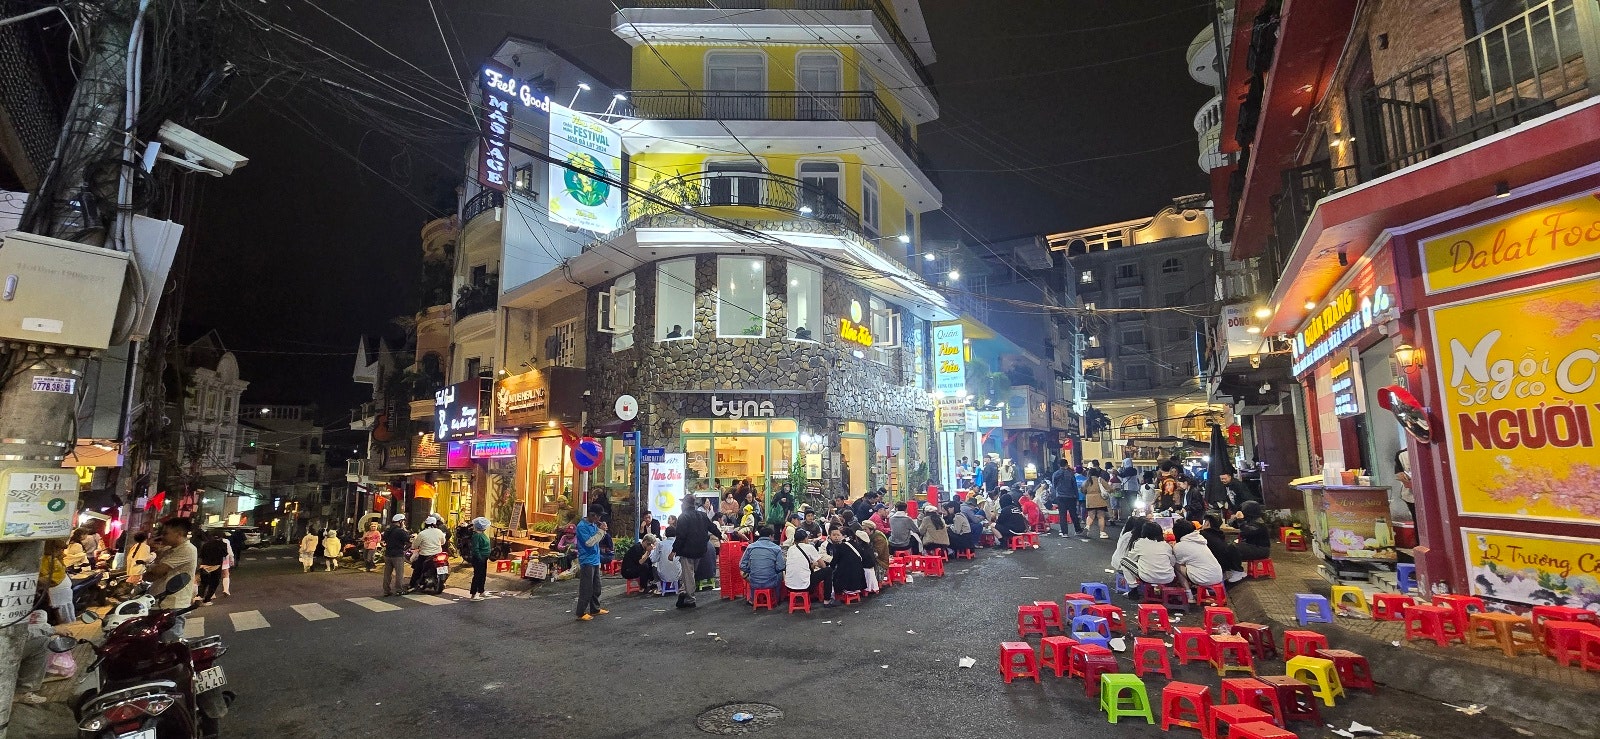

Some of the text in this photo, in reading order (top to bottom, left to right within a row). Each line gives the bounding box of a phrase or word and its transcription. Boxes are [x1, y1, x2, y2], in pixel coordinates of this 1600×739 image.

[485, 69, 550, 112] Feel Good
[486, 95, 508, 185] MASSAGE
[574, 126, 610, 147] FESTIVAL
[1450, 228, 1538, 274] Dalat
[938, 342, 960, 356] Hoa
[1450, 329, 1553, 400] Ngồi
[711, 395, 775, 420] tyna
[1458, 396, 1594, 450] NGƯỜI
[33, 474, 61, 482] P050
[1481, 543, 1503, 562] 12
